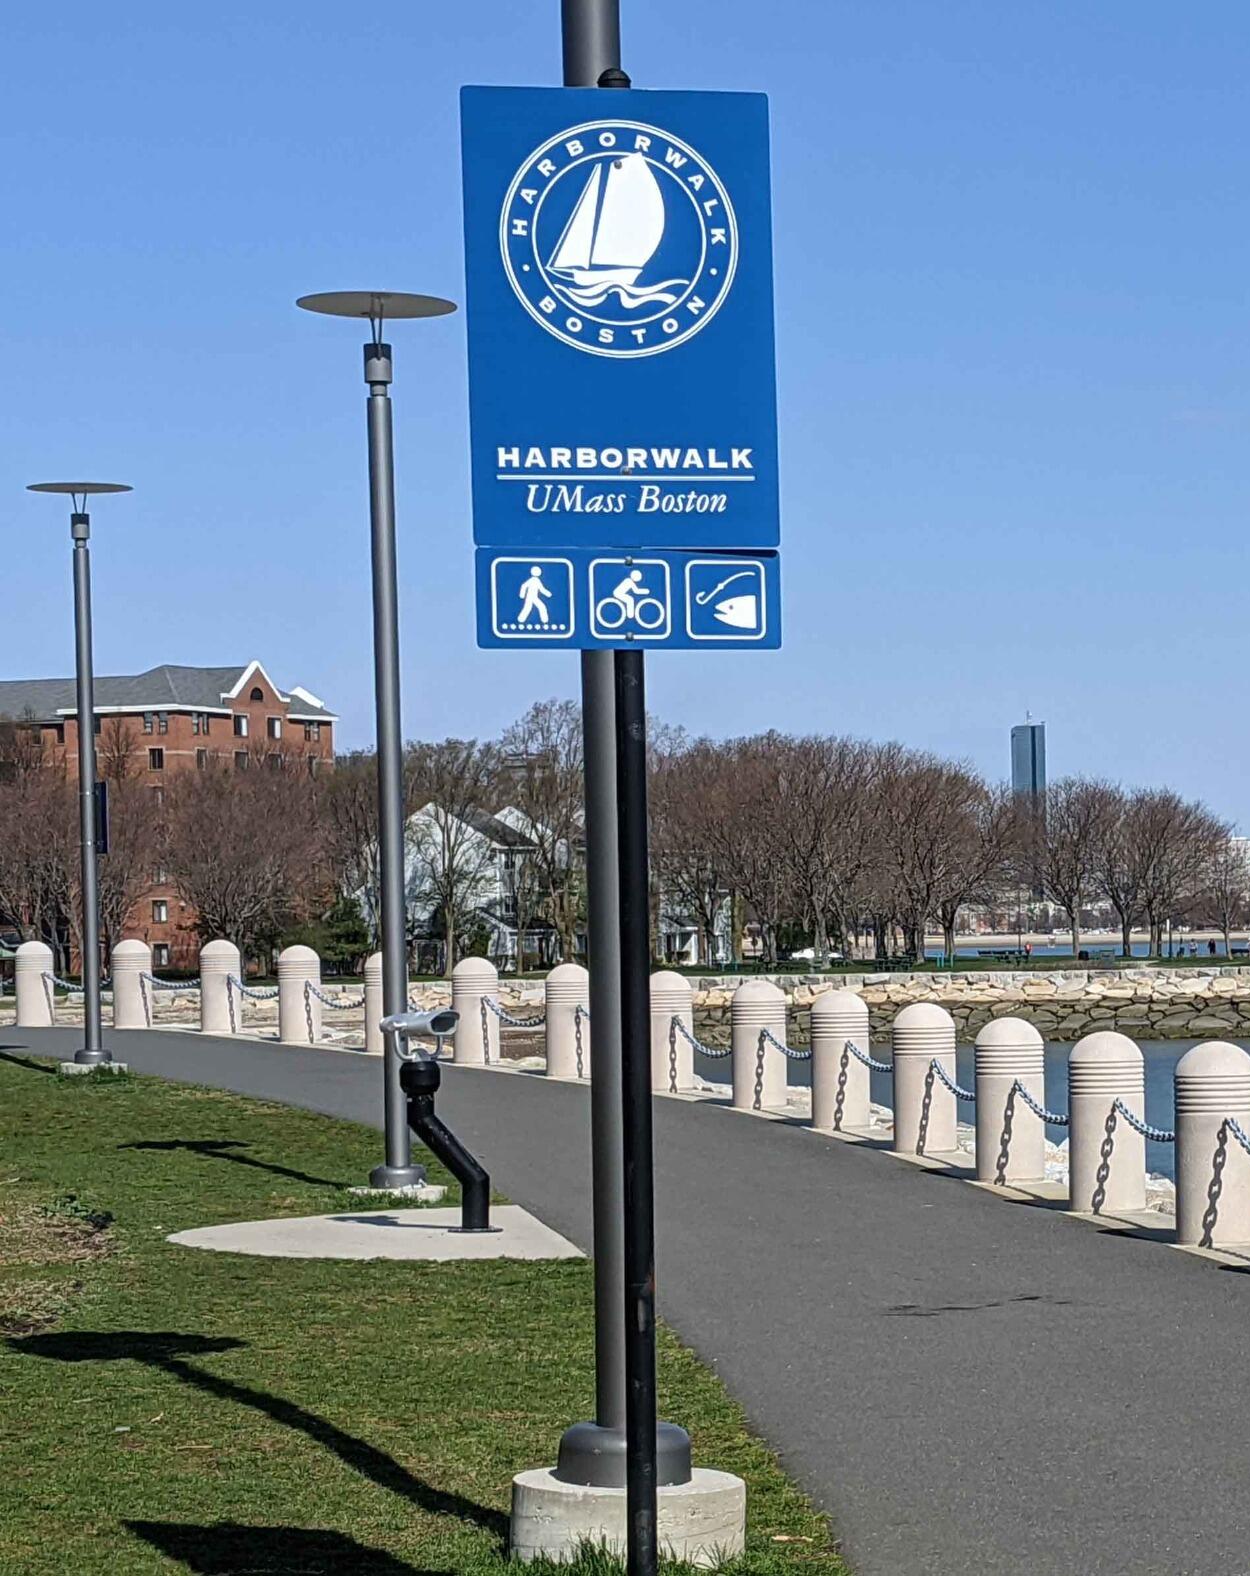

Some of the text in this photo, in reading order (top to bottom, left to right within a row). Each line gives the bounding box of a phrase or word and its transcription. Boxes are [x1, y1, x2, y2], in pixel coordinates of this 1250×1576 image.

[512, 132, 726, 245] HARBORWALK
[539, 296, 705, 344] BOSTON
[497, 447, 754, 469] HARBORWALK
[526, 485, 727, 513] UMass Boston
